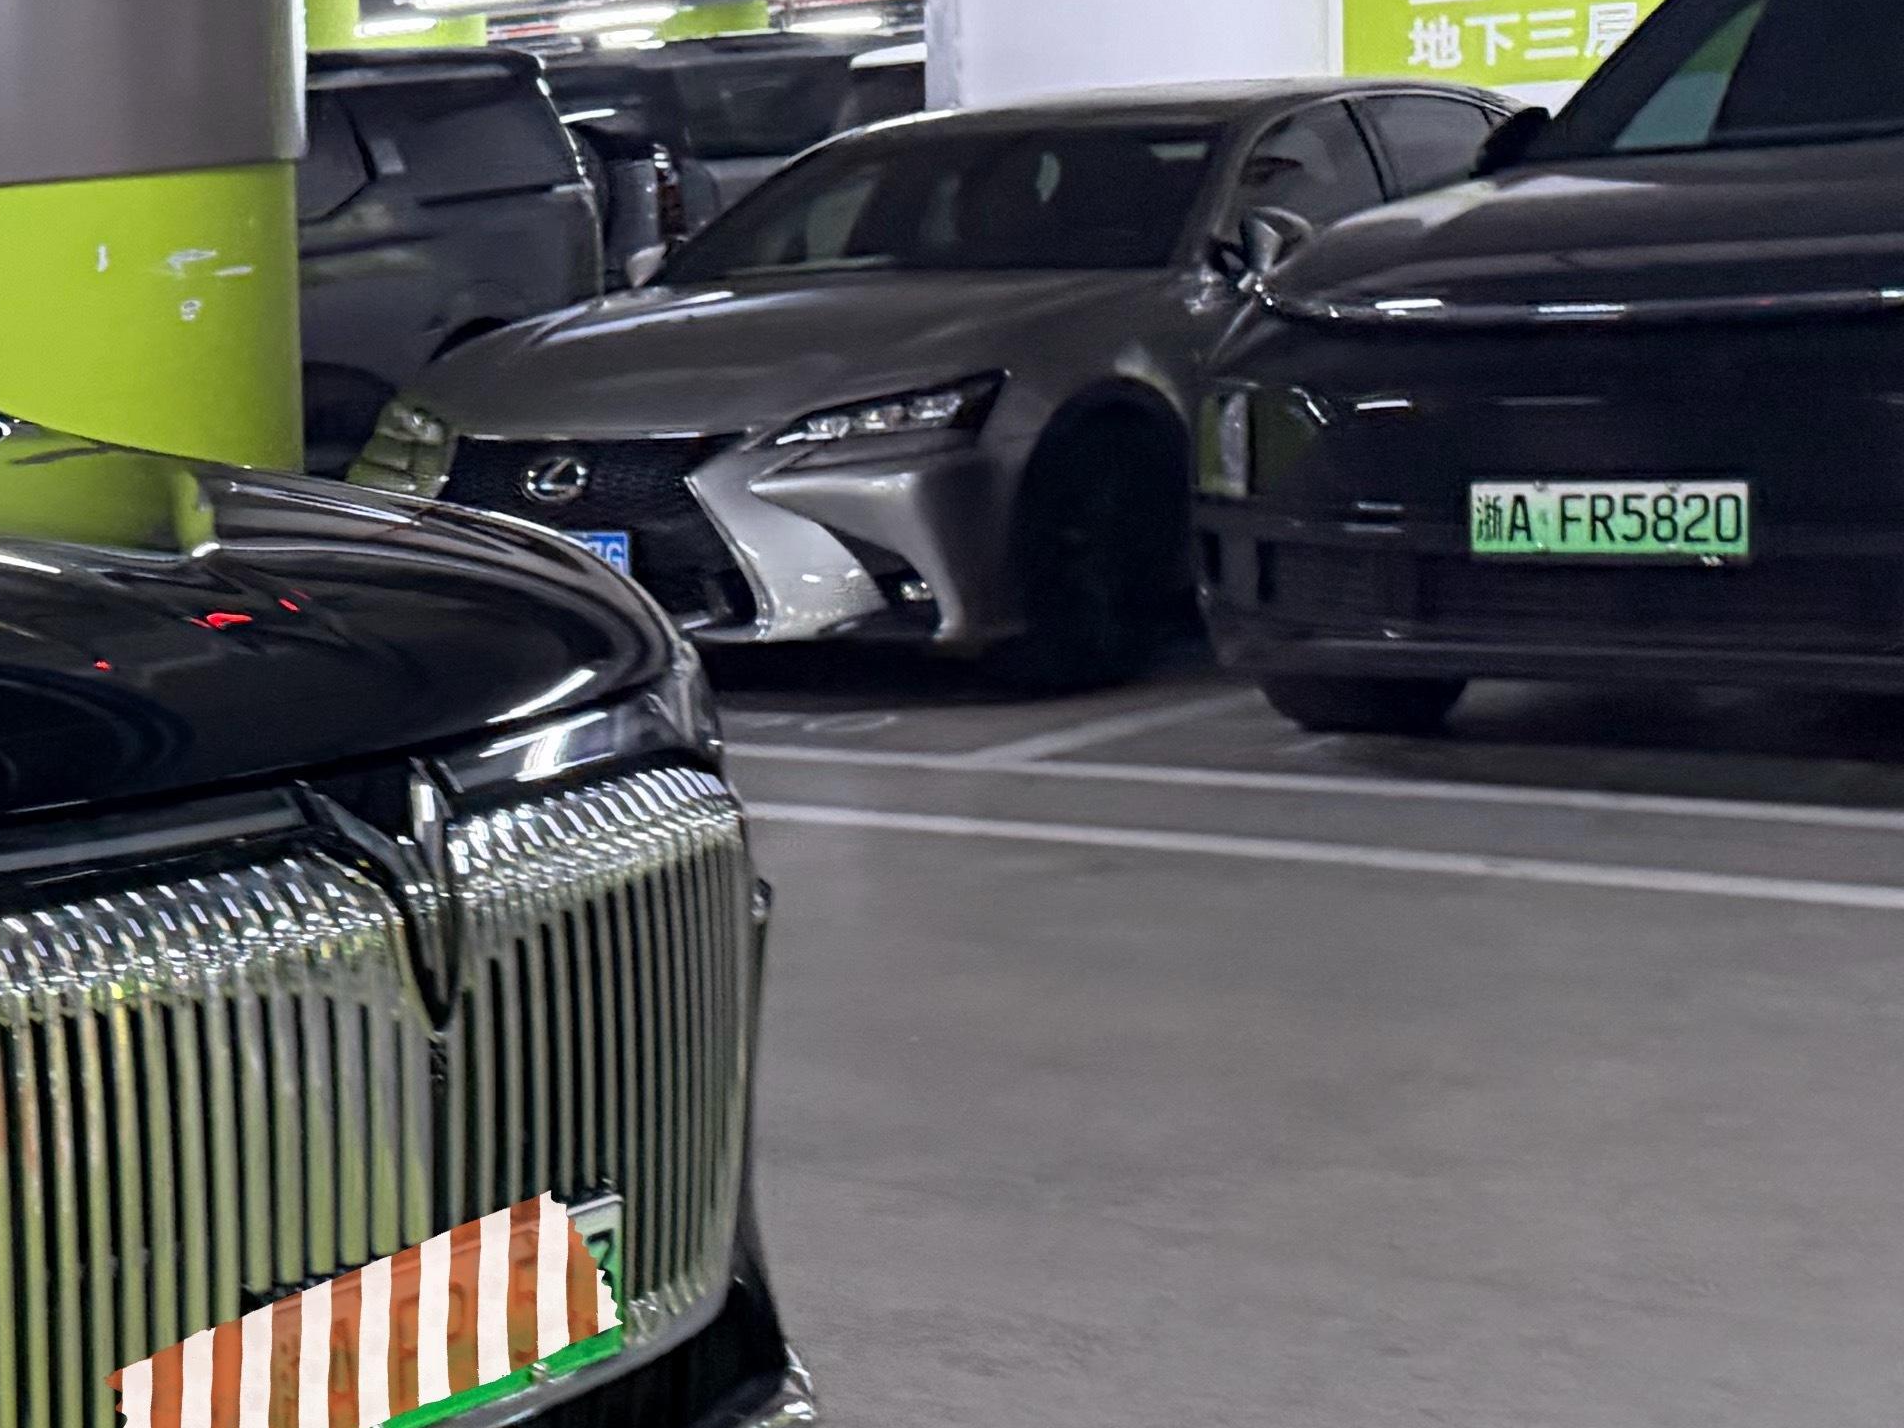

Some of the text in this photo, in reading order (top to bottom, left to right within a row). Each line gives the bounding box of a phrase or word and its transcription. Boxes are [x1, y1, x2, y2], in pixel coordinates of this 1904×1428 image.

[1407, 1, 1637, 67] 地下三层
[1559, 493, 1742, 543] FR5820
